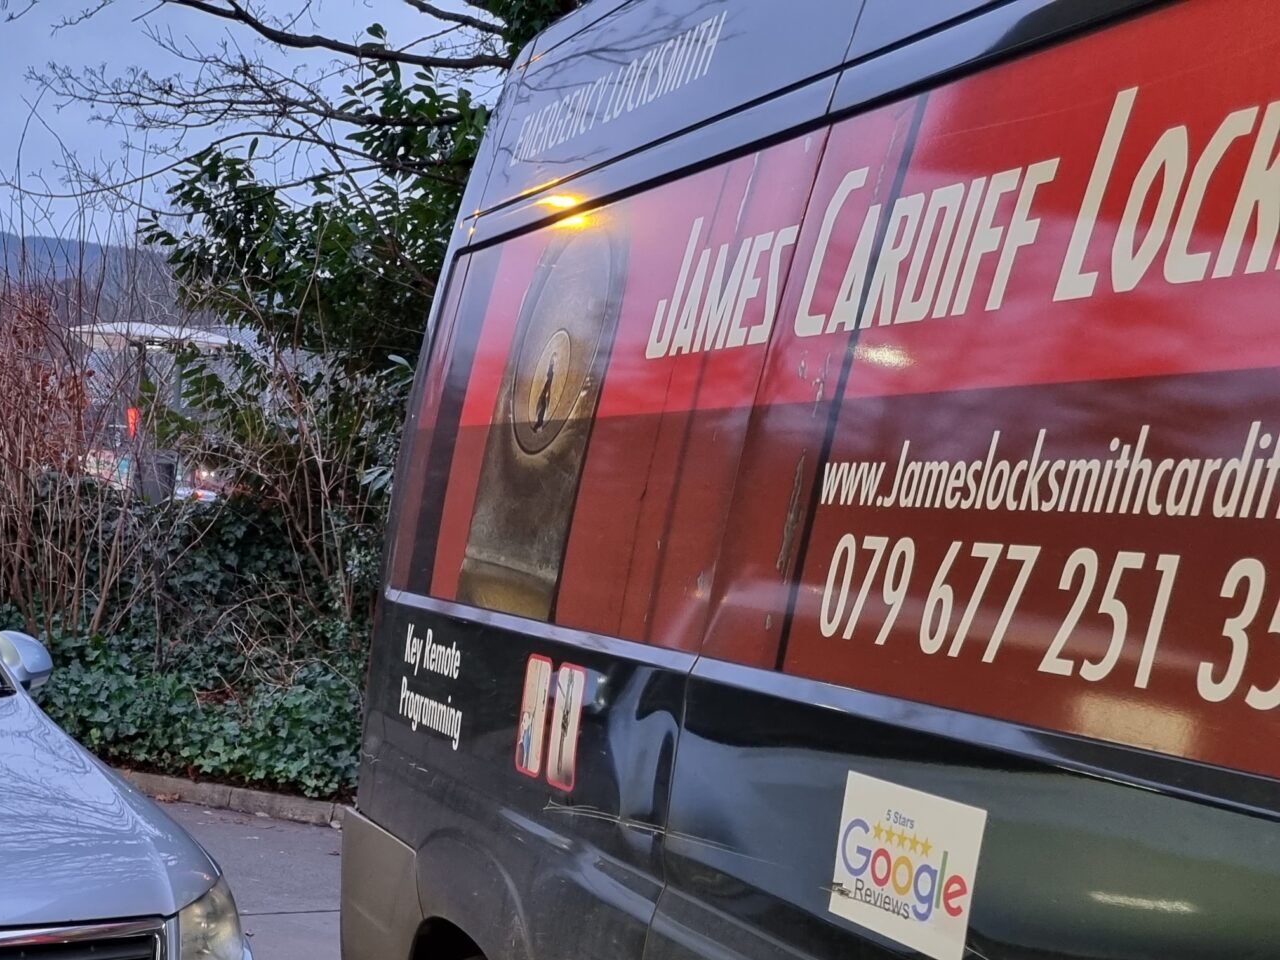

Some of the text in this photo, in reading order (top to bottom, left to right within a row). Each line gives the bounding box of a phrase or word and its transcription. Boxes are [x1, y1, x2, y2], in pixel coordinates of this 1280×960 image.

[510, 10, 728, 167] EMERGENCY LOCKSMITH
[645, 86, 1280, 360] JAMES CARDIFF LOCK
[404, 623, 461, 680] Key Remote
[819, 533, 916, 646] 079
[919, 541, 1042, 663] 677
[1037, 547, 1181, 690] 251
[399, 675, 463, 751] Programming
[885, 809, 915, 830] 5 Stars
[841, 818, 968, 922] Google
[854, 878, 910, 920] Reviews
